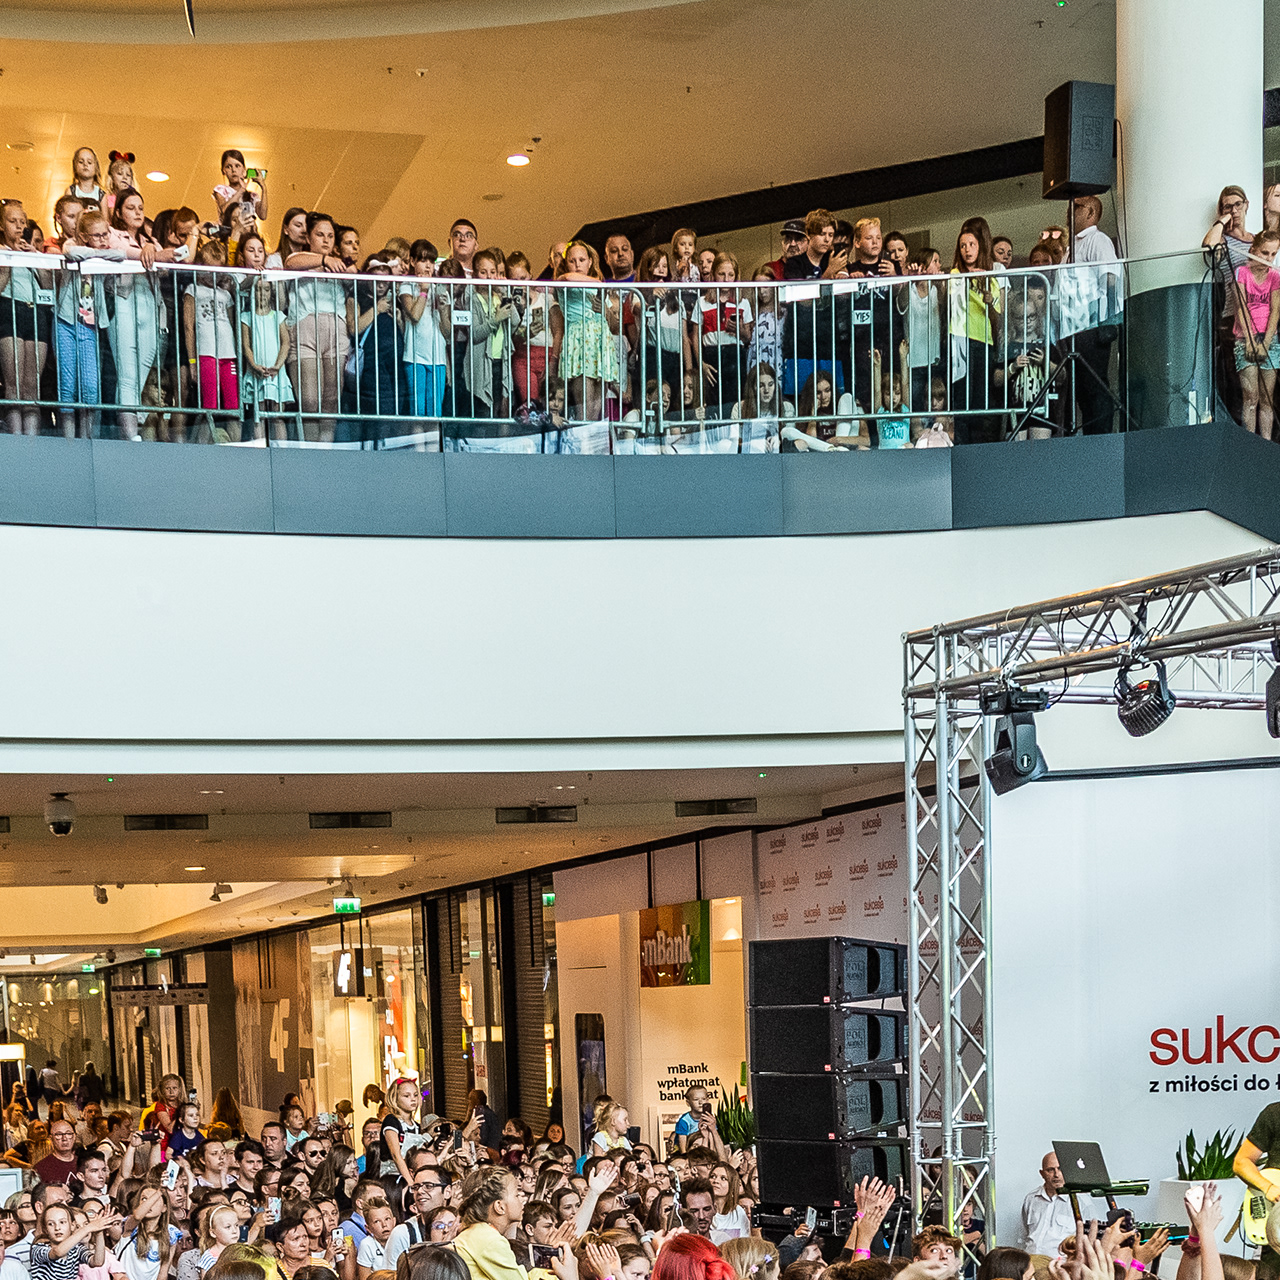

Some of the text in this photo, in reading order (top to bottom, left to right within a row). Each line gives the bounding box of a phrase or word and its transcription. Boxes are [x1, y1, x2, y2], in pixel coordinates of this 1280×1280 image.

[643, 924, 693, 967] mBank
[270, 998, 290, 1073] 4F
[667, 1062, 709, 1075] mBank
[657, 1076, 720, 1091] wpłatomat
[1149, 1080, 1160, 1093] z
[1165, 1073, 1238, 1092] miłości
[1243, 1073, 1270, 1091] do
